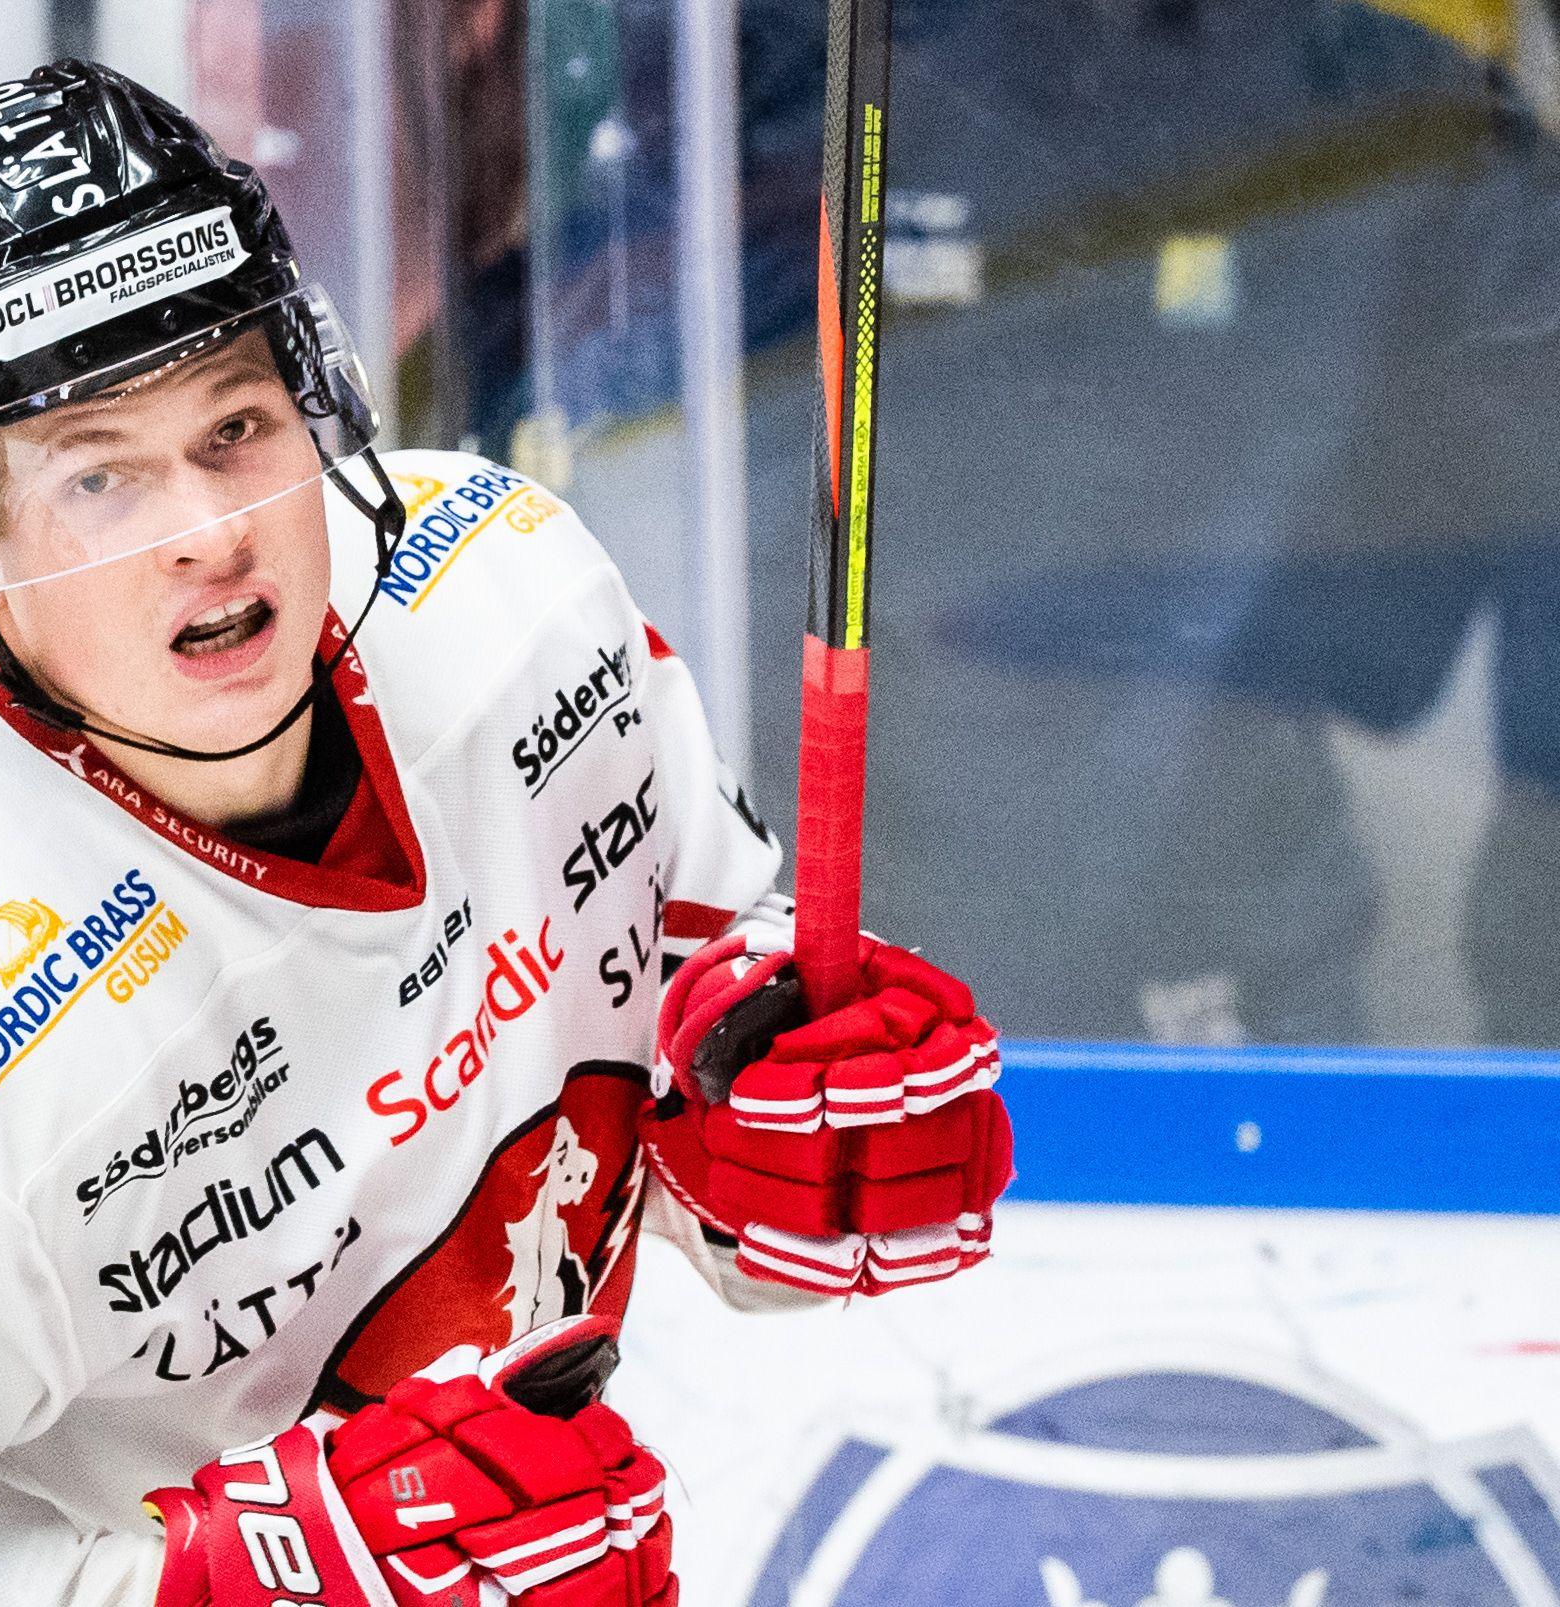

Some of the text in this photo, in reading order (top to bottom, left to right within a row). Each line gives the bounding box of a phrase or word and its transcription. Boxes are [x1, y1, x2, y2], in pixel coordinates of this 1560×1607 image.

[377, 500, 479, 606] NORDIC
[92, 768, 269, 881] ARA SECURITY
[65, 868, 158, 971] BRASS
[105, 910, 189, 1005] GUSUM
[366, 915, 564, 1147] Scandic
